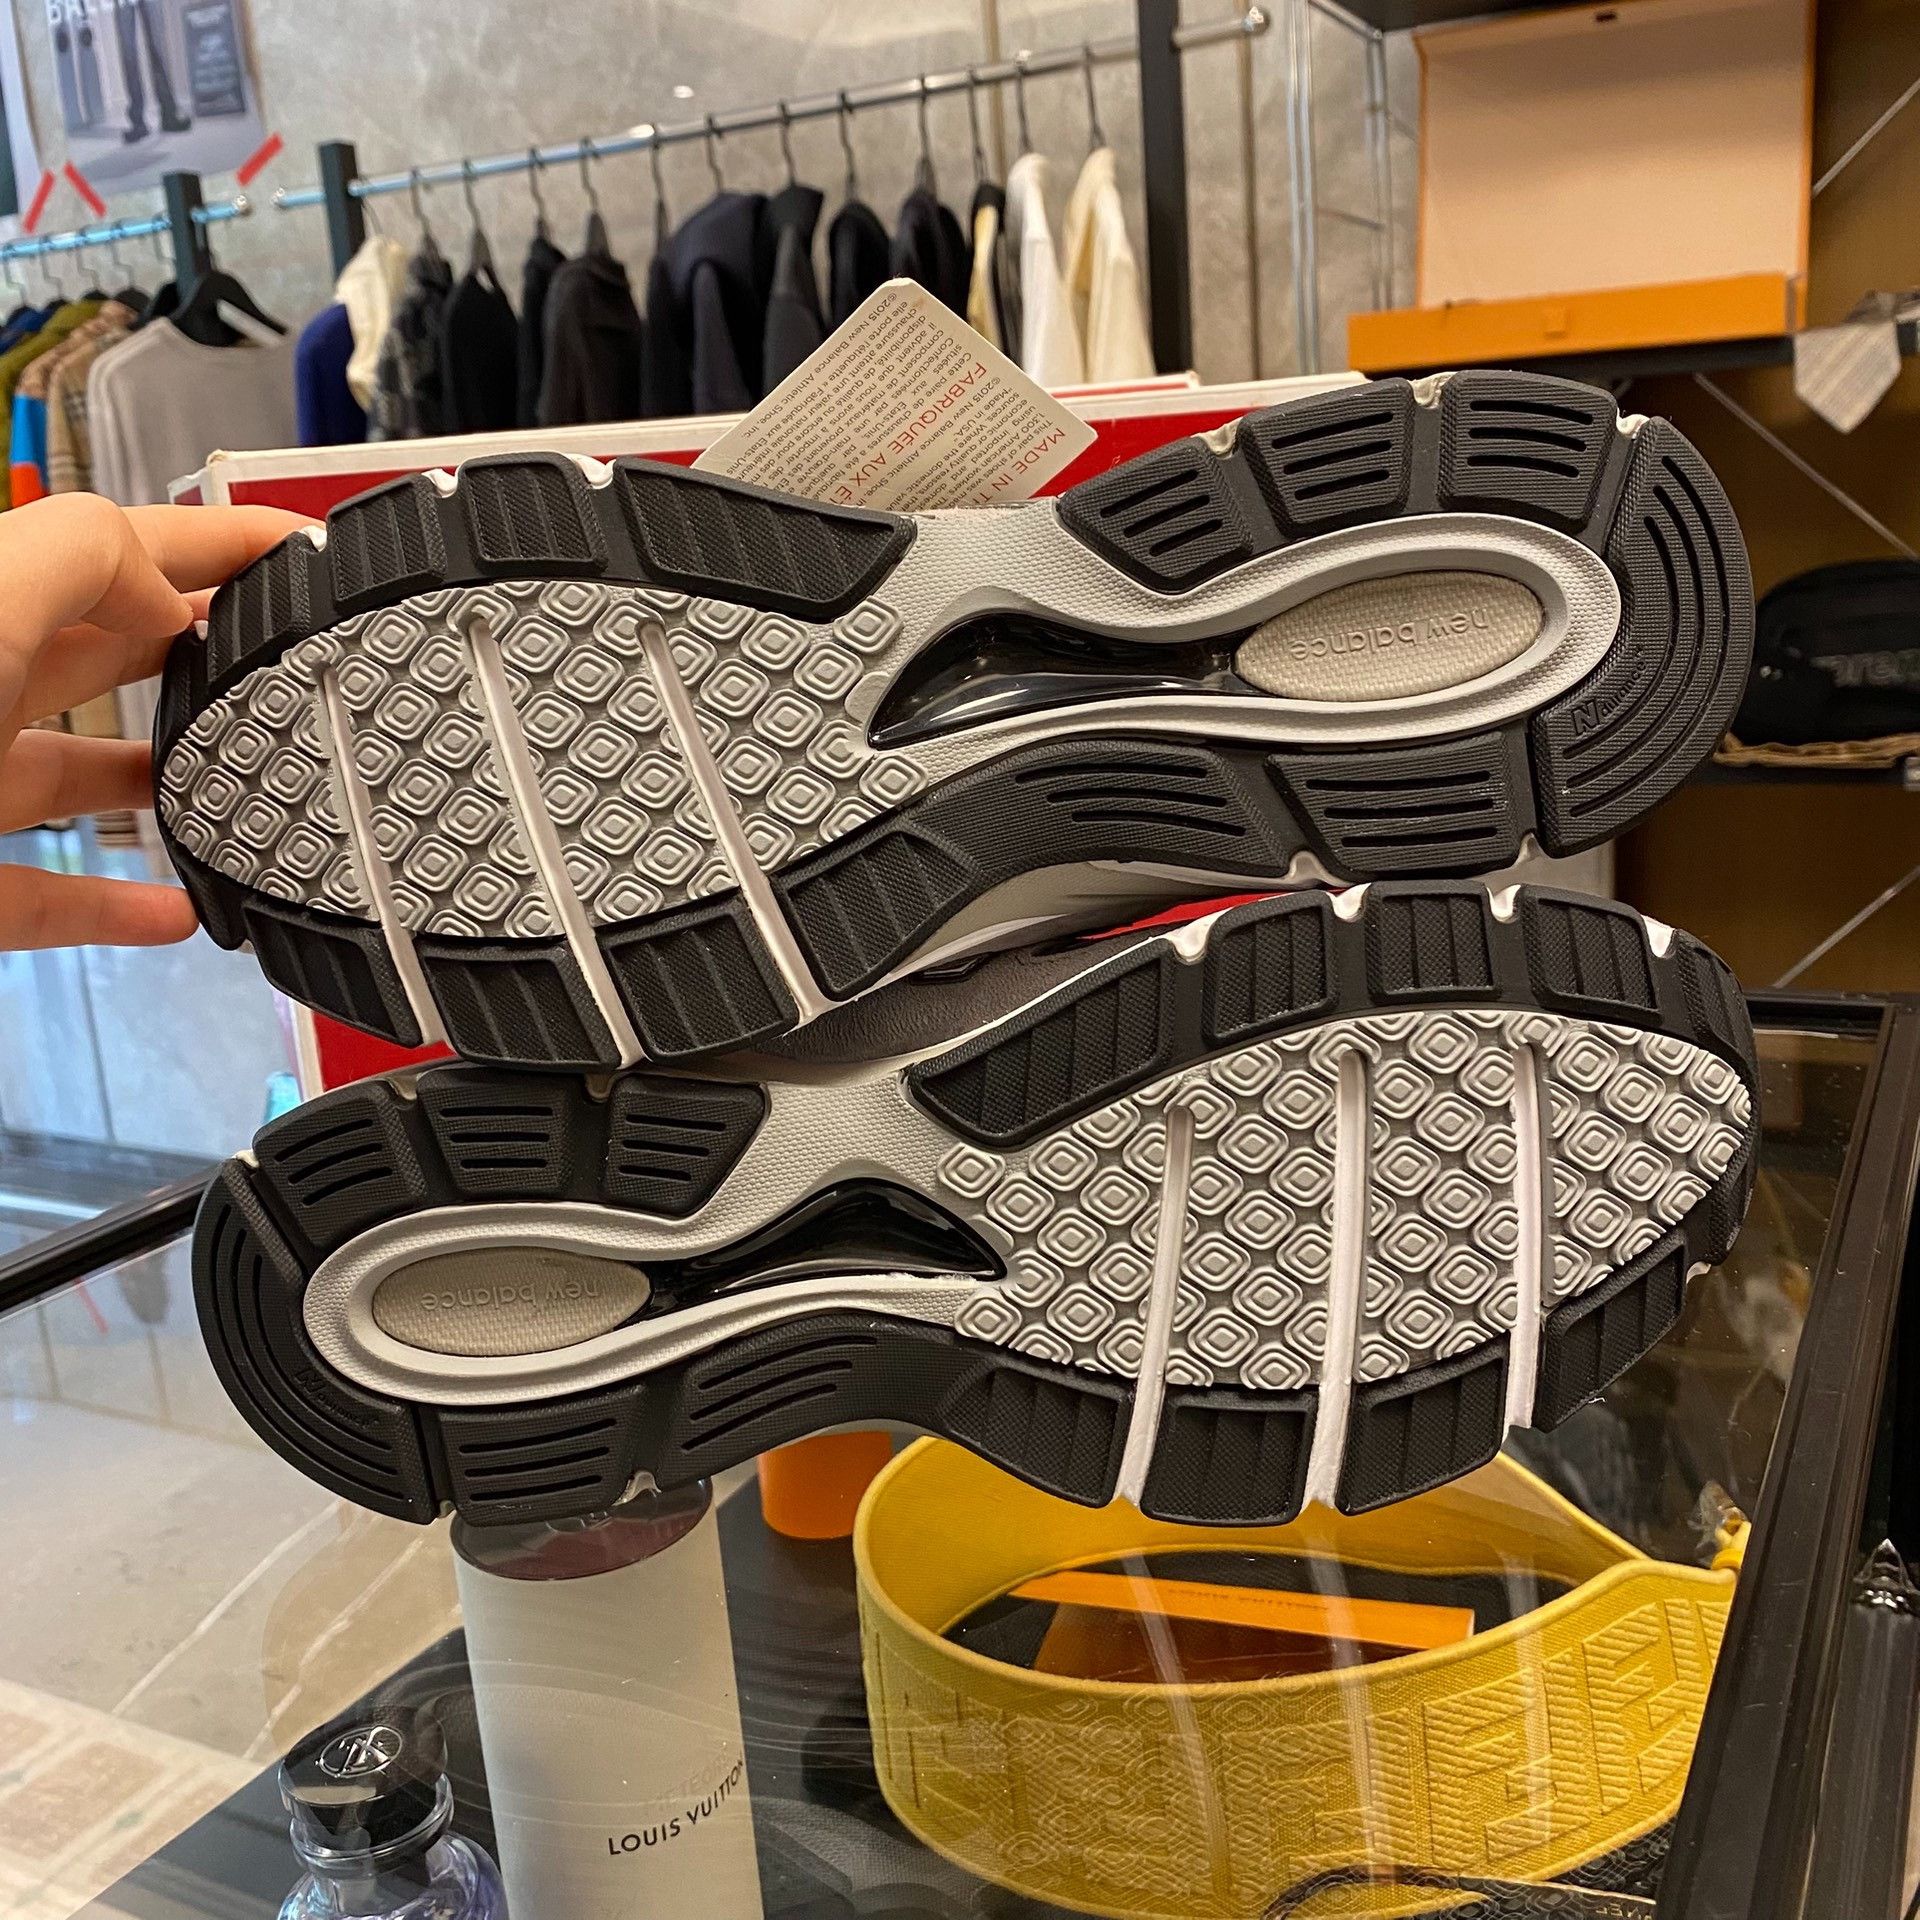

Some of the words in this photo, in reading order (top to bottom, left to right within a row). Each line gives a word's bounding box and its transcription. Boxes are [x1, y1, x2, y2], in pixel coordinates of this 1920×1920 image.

[890, 300, 910, 318] elle
[846, 319, 870, 342] New
[865, 315, 895, 342] porte
[872, 306, 919, 350] chaussure
[927, 321, 937, 330] il
[812, 339, 850, 375] Balance
[893, 329, 931, 363] advient
[894, 328, 949, 378] composent
[846, 348, 878, 378] atteint
[887, 336, 958, 400] Confectionnées
[929, 343, 965, 375] situées
[944, 350, 974, 377] Cette
[861, 366, 878, 381] de
[874, 362, 896, 382] que
[883, 376, 900, 391] de
[780, 372, 817, 406] Athletic
[830, 376, 850, 394] une
[832, 377, 866, 408] qualité
[854, 382, 878, 403] nous
[909, 379, 928, 396] aux
[922, 375, 949, 398] paire
[779, 385, 825, 427] Fabriquée
[805, 391, 834, 417] valeur
[821, 404, 836, 417] ou
[827, 401, 855, 426] avons
[843, 388, 887, 429] matériaux
[871, 400, 889, 416] par
[884, 361, 992, 457] FABRIQUÉE
[911, 397, 927, 411] de
[950, 400, 975, 422] New
[973, 409, 986, 420] in
[1010, 404, 1037, 427] using
[764, 422, 783, 438] aux
[793, 414, 824, 443] encore
[852, 417, 871, 434] une
[866, 408, 914, 451] chaussures
[985, 398, 1030, 437] economic
[1018, 410, 1045, 434] 1,300
[1032, 418, 1053, 436] This
[769, 413, 809, 450] nationale
[917, 418, 955, 451] Balance
[956, 422, 987, 449] Where
[975, 434, 989, 445] or
[1014, 432, 1035, 450] pair
[773, 439, 796, 459] pour
[783, 432, 821, 466] importer
[802, 425, 845, 464] provenant
[840, 443, 858, 458] par
[941, 447, 959, 462] the
[947, 442, 979, 470] quality
[969, 428, 1010, 464] imported
[979, 431, 1022, 468] American
[1005, 447, 1019, 459] of
[1010, 427, 1066, 474] MADE
[758, 457, 778, 474] des
[766, 464, 786, 482] des
[786, 461, 806, 479] des
[843, 455, 861, 470] été
[848, 451, 890, 487] AUX
[885, 448, 922, 480] Athletic
[949, 464, 969, 481] and
[981, 456, 1009, 479] shoes
[797, 461, 839, 497] quelques
[904, 459, 945, 494] domestic
[915, 466, 951, 498] reasons,
[965, 476, 985, 493] was
[990, 472, 1014, 492] IN
[1428, 608, 1489, 639] new
[1290, 622, 1417, 660] balance
[421, 1283, 537, 1311] balance
[545, 1279, 599, 1300] new
[608, 1817, 681, 1856] LOUIS
